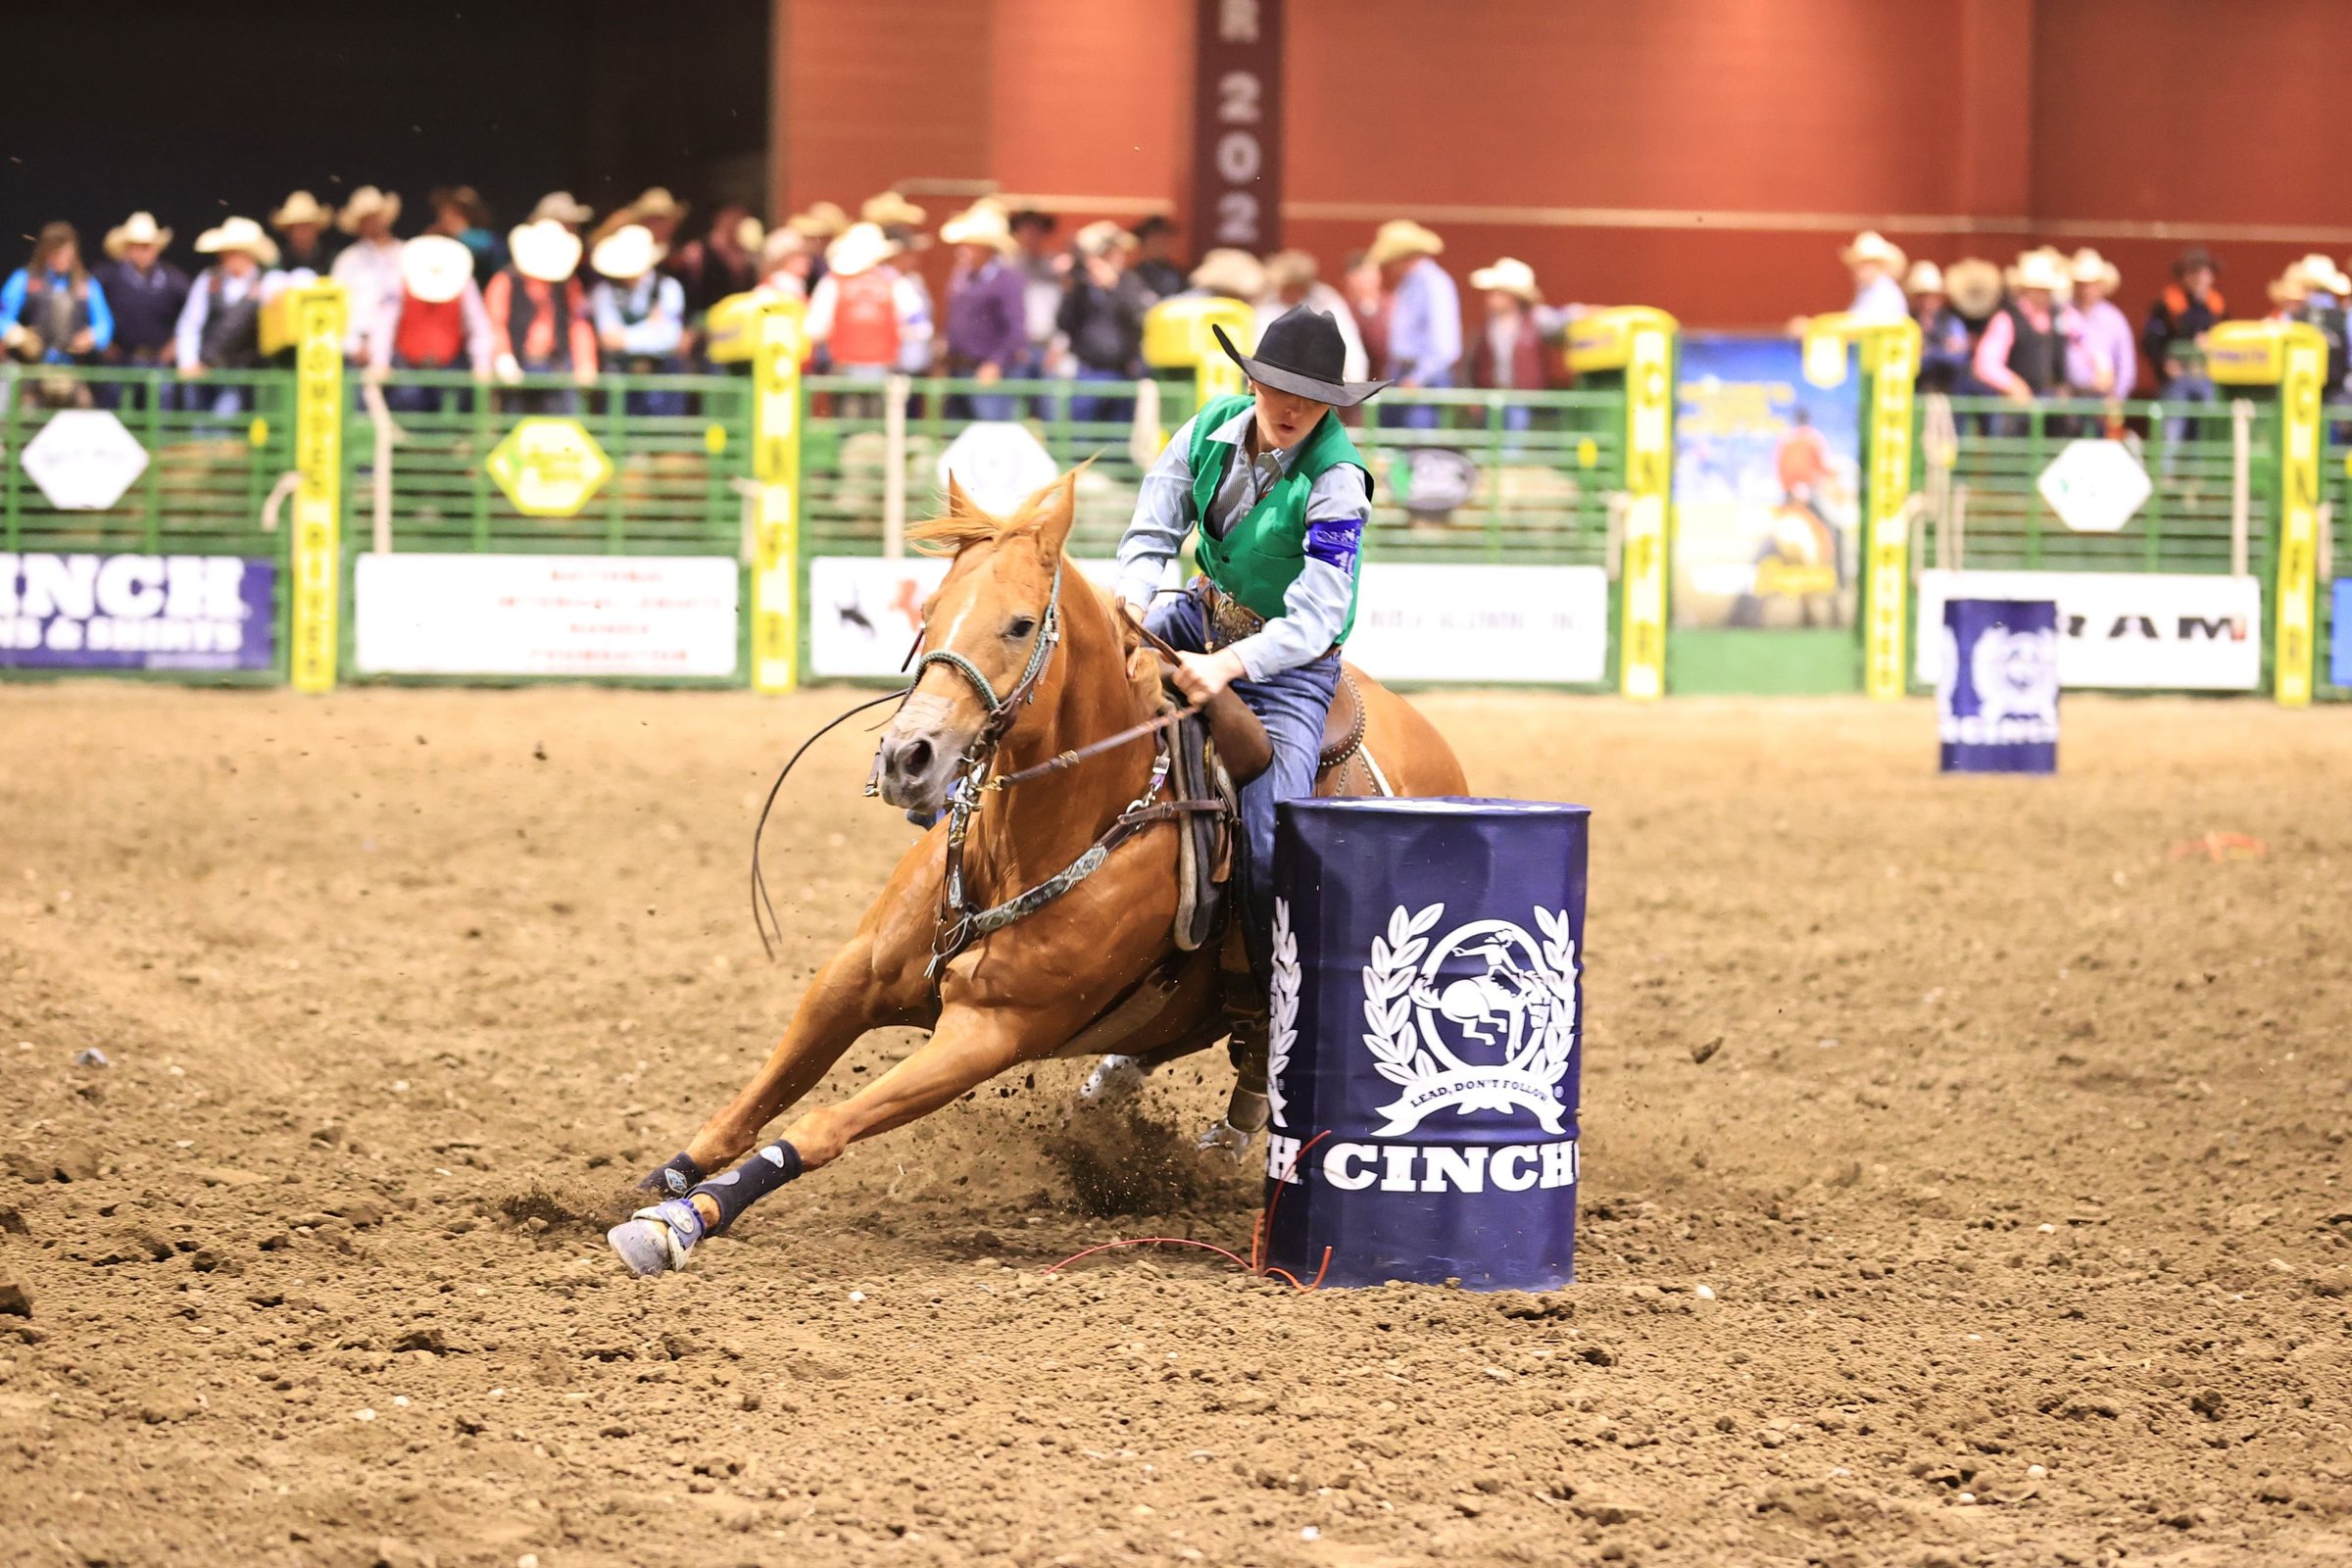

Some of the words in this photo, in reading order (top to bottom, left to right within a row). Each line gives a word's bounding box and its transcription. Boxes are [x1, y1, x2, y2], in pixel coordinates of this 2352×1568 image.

[1410, 1087, 1452, 1107] LEAD,
[1454, 1080, 1498, 1092] DON'T
[1323, 1141, 1575, 1193] CINCH
